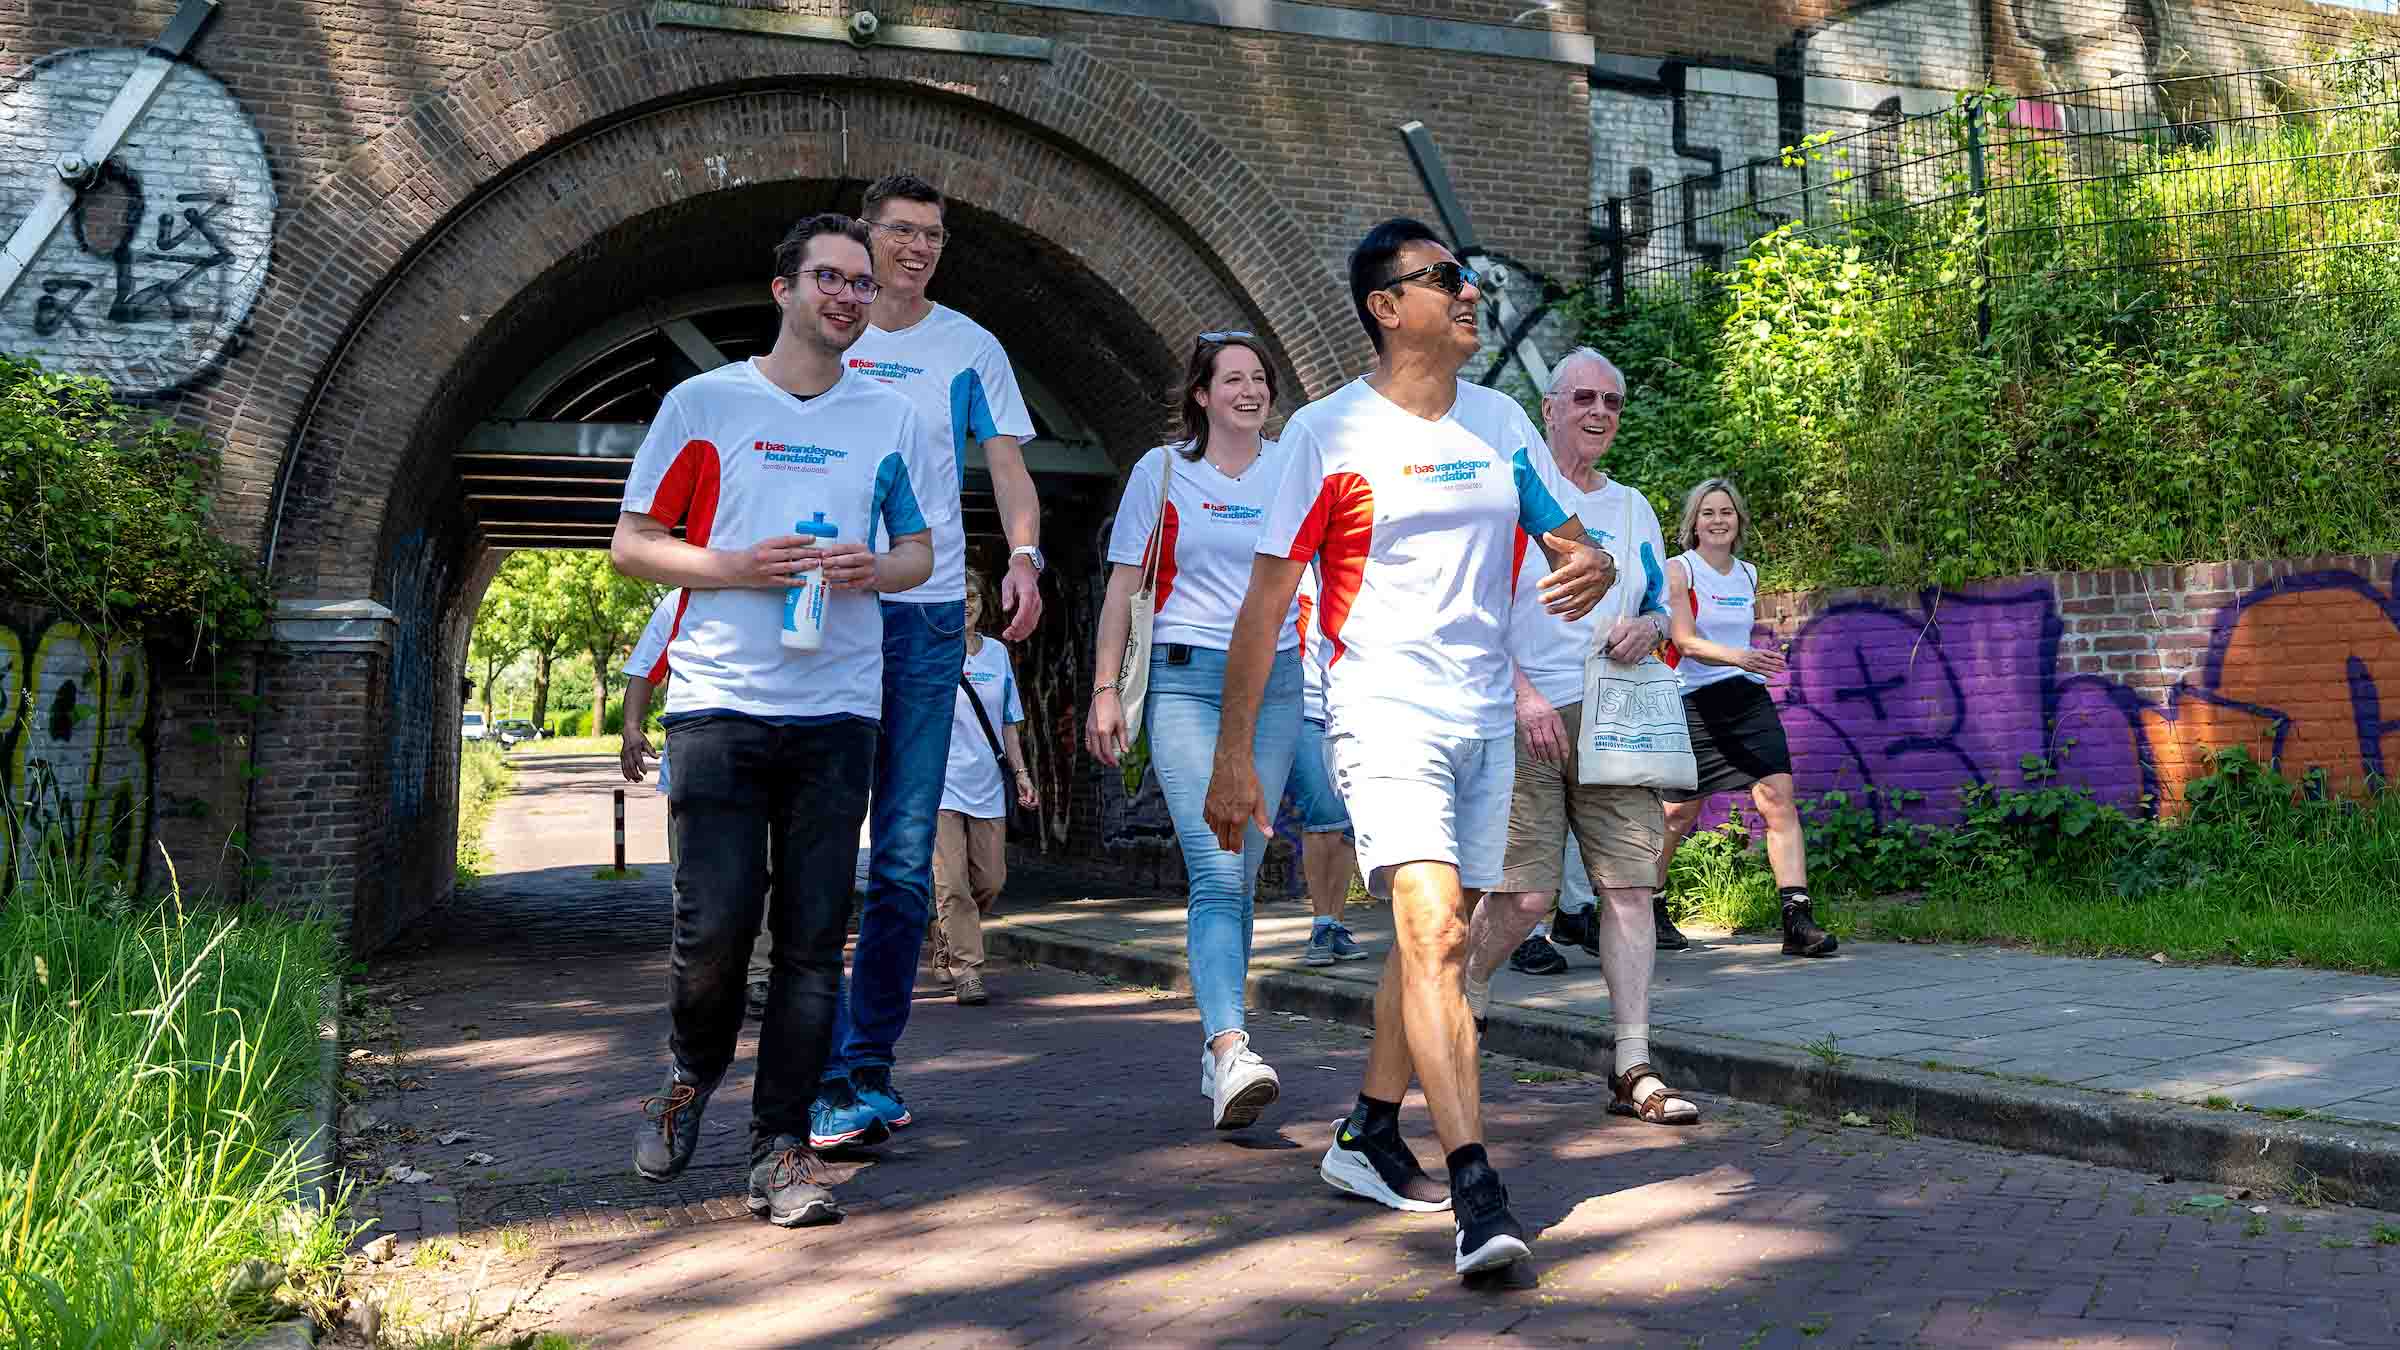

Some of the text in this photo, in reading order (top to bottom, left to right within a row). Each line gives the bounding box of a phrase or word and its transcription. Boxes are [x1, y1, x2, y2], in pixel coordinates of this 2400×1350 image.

[765, 452, 826, 464] foundation
[766, 441, 848, 458] basvandegoor
[1600, 687, 1675, 718] START
